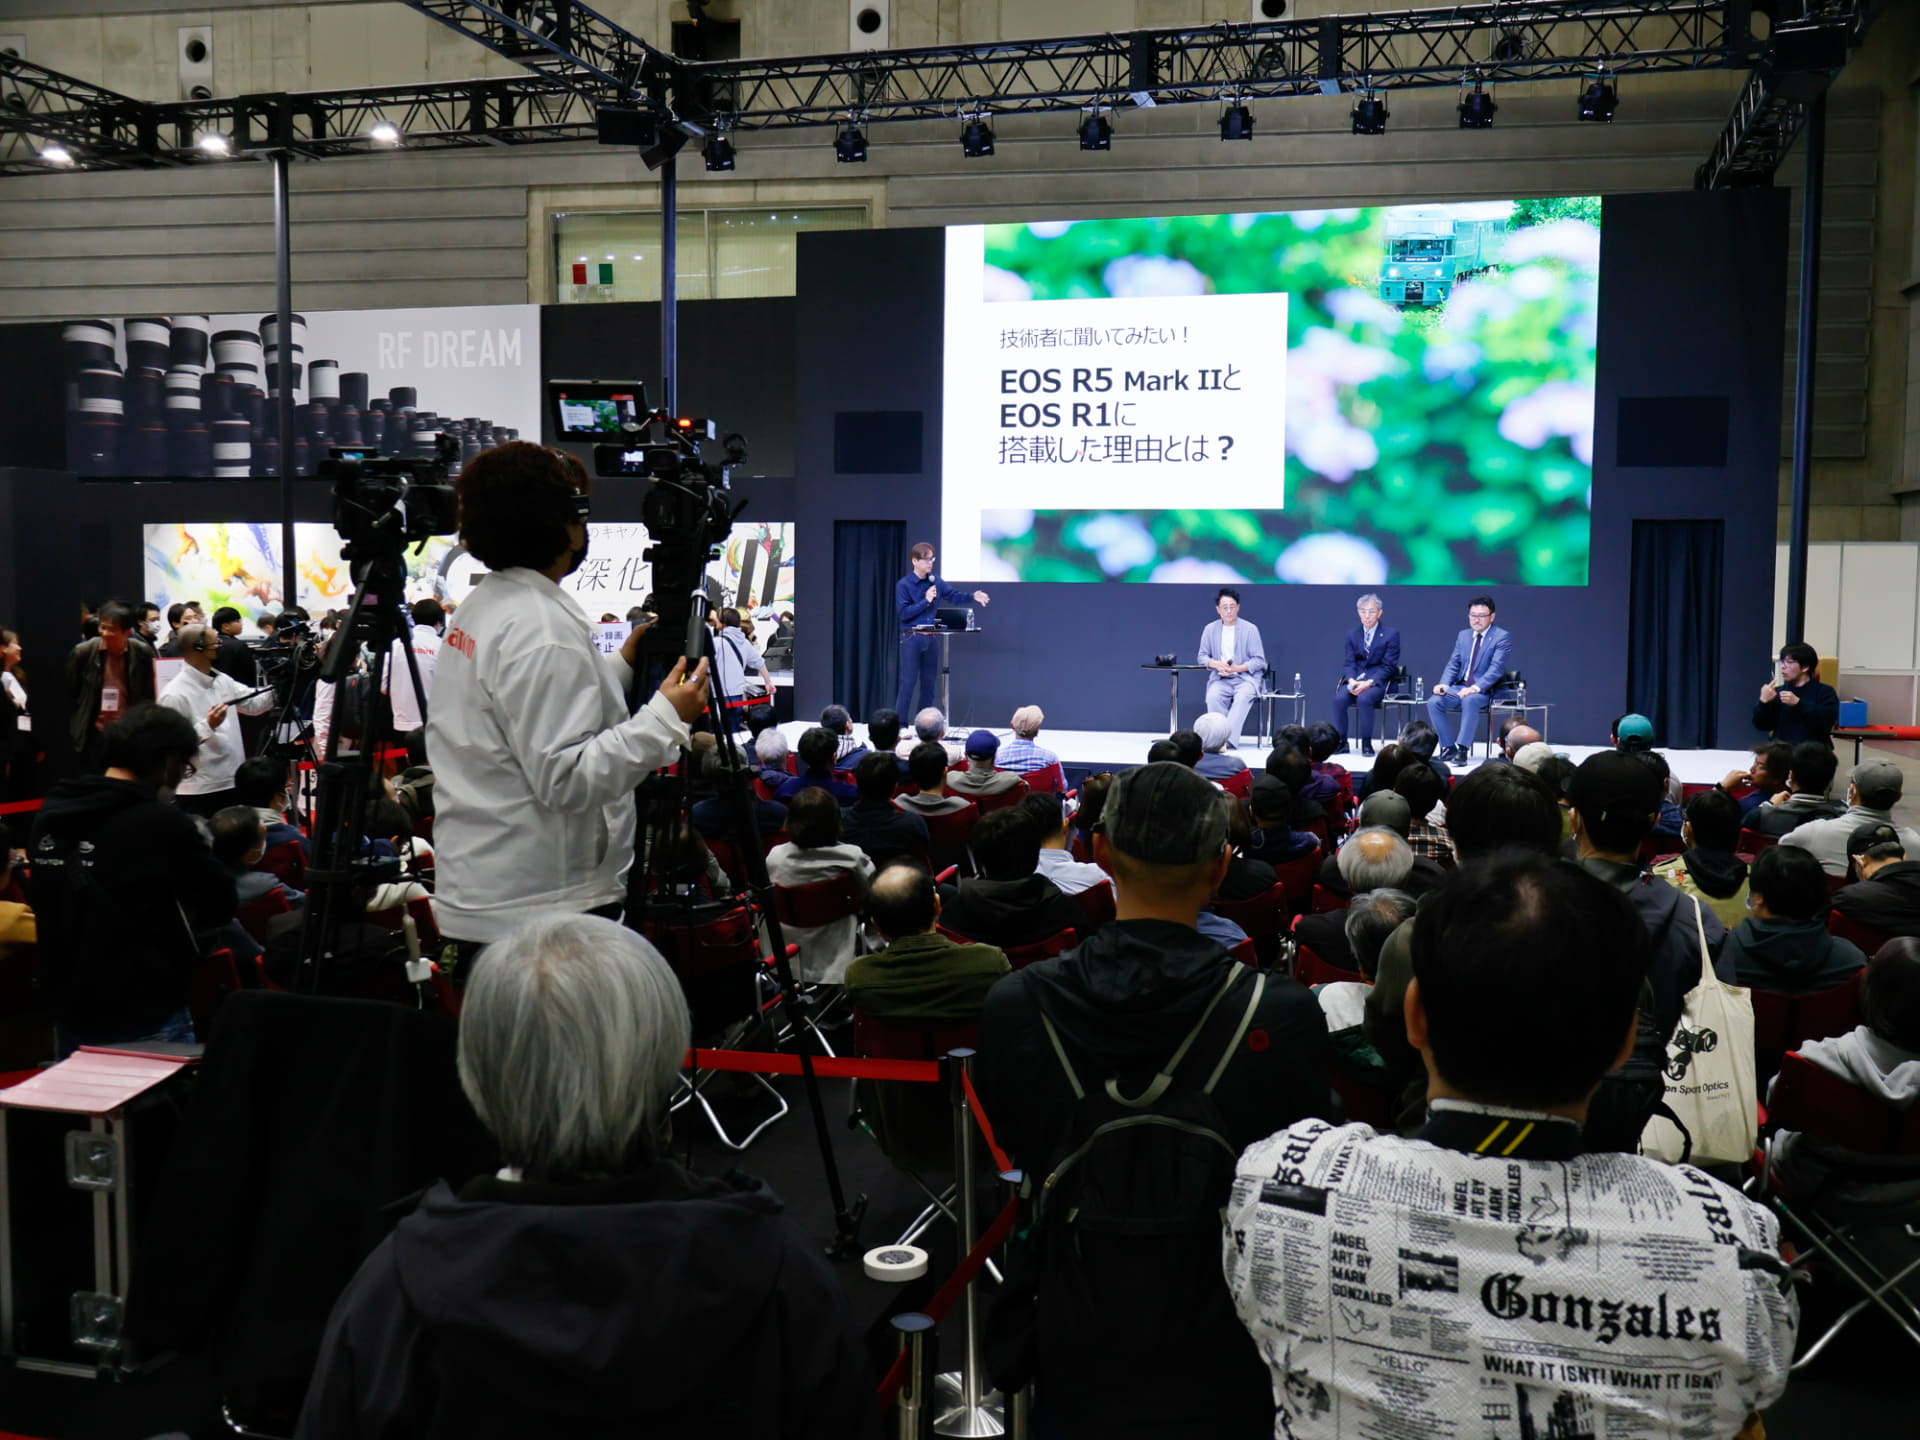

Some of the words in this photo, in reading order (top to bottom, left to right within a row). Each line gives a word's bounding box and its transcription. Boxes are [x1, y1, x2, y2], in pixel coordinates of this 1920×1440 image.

[377, 331, 413, 369] RF
[423, 328, 522, 369] DREAM
[1000, 326, 1188, 349] 技術者に聞いてみたい！
[1000, 368, 1062, 394] EOS
[1072, 366, 1113, 393] R5
[1124, 369, 1190, 392] Mark
[1000, 402, 1062, 428] EOS
[1702, 1081, 1729, 1094] Optics
[1454, 1180, 1468, 1215] NGEL
[1507, 1163, 1522, 1223] ONZALES
[1332, 1231, 1368, 1252] ANGEL
[1332, 1249, 1354, 1265] ART
[1357, 1254, 1372, 1270] BY
[1332, 1265, 1367, 1285] MARK
[1332, 1282, 1394, 1308] GONZALES
[1480, 1271, 1723, 1345] Gonzales
[1483, 1354, 1535, 1379] WHAT
[1540, 1363, 1555, 1381] IT
[1610, 1368, 1663, 1390] WHAT
[1666, 1372, 1682, 1390] IT
